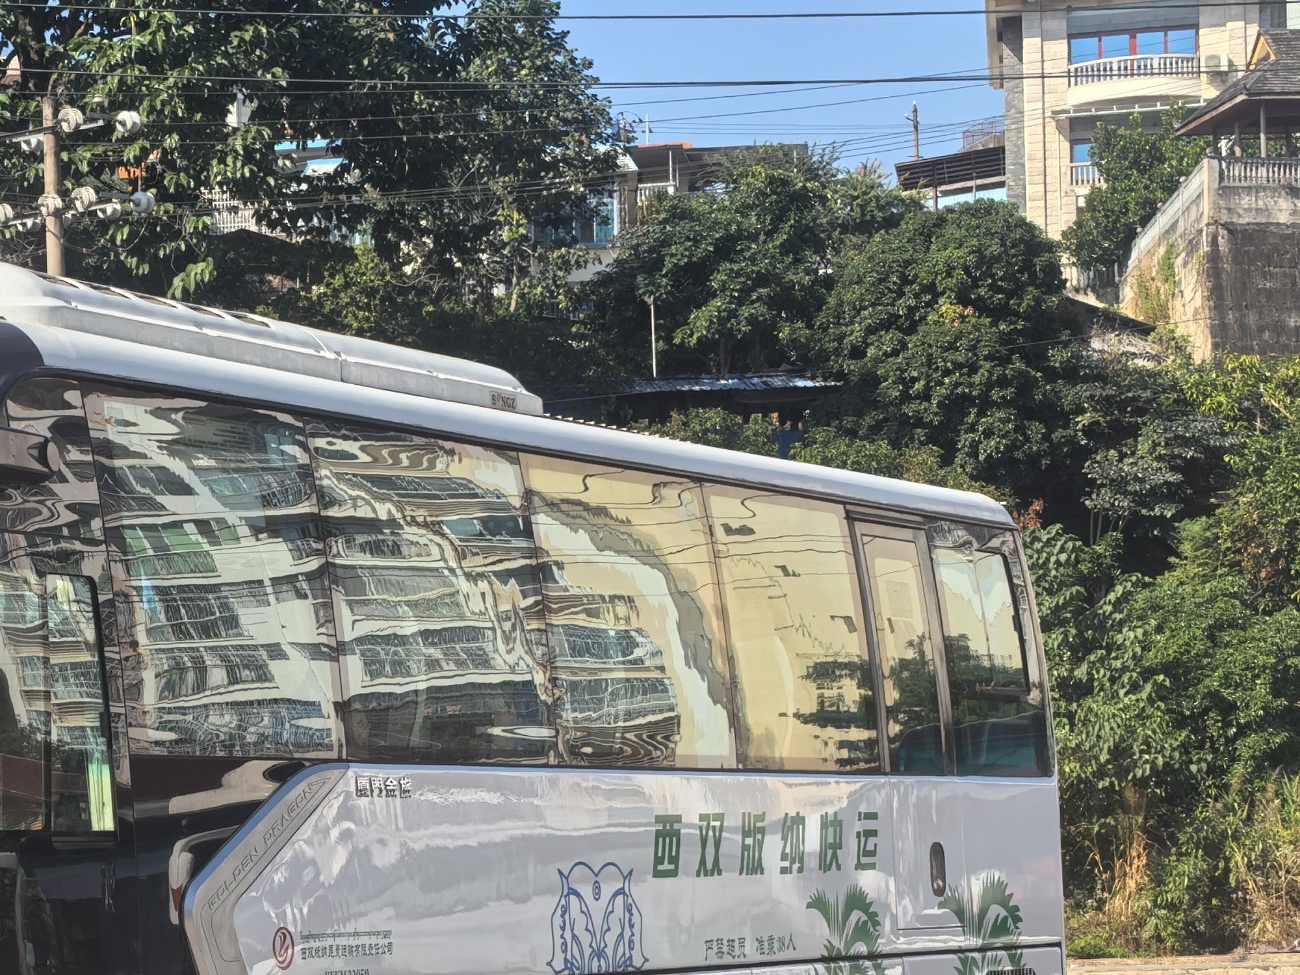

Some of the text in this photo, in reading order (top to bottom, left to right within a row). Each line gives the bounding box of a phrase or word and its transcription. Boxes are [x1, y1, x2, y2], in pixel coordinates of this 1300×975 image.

[652, 811, 879, 878] 西双版纳快运
